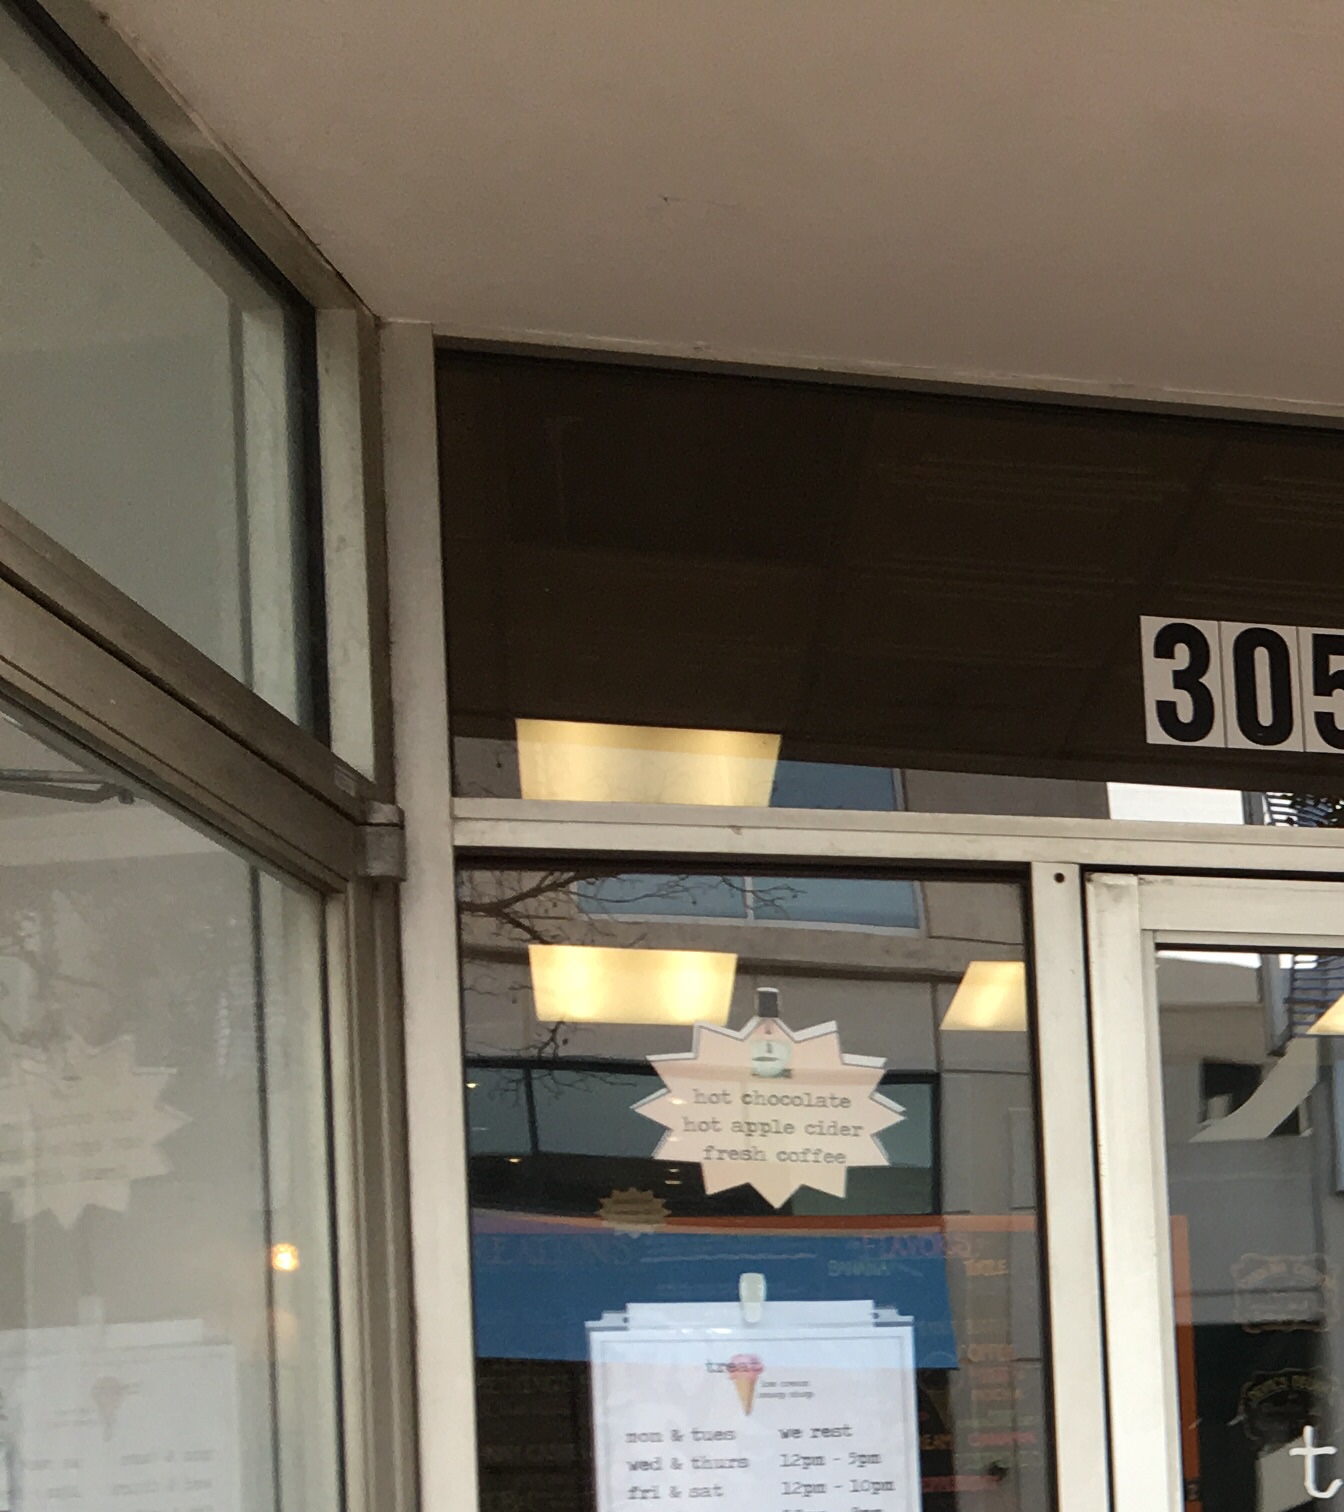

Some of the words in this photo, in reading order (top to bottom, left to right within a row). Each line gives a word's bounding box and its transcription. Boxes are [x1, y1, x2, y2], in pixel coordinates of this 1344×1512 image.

[692, 1088, 734, 1106] hot
[741, 1089, 853, 1110] chocolate
[682, 1115, 723, 1134] hot
[730, 1118, 796, 1139] apple
[803, 1121, 865, 1138] cider
[702, 1144, 767, 1162] fresh
[775, 1147, 848, 1165] coffee
[624, 1429, 663, 1444] mon
[670, 1428, 686, 1443] &
[690, 1427, 737, 1442] tues
[777, 1426, 803, 1440] we
[809, 1423, 855, 1439] rest
[625, 1456, 663, 1473] wed
[669, 1456, 684, 1471] &
[690, 1454, 751, 1470] thurs
[779, 1453, 827, 1470] 12pm
[626, 1483, 662, 1501] fri
[668, 1483, 683, 1499] &
[687, 1482, 726, 1499] sat
[780, 1480, 828, 1498] 12pm
[848, 1478, 897, 1496] 10pm
